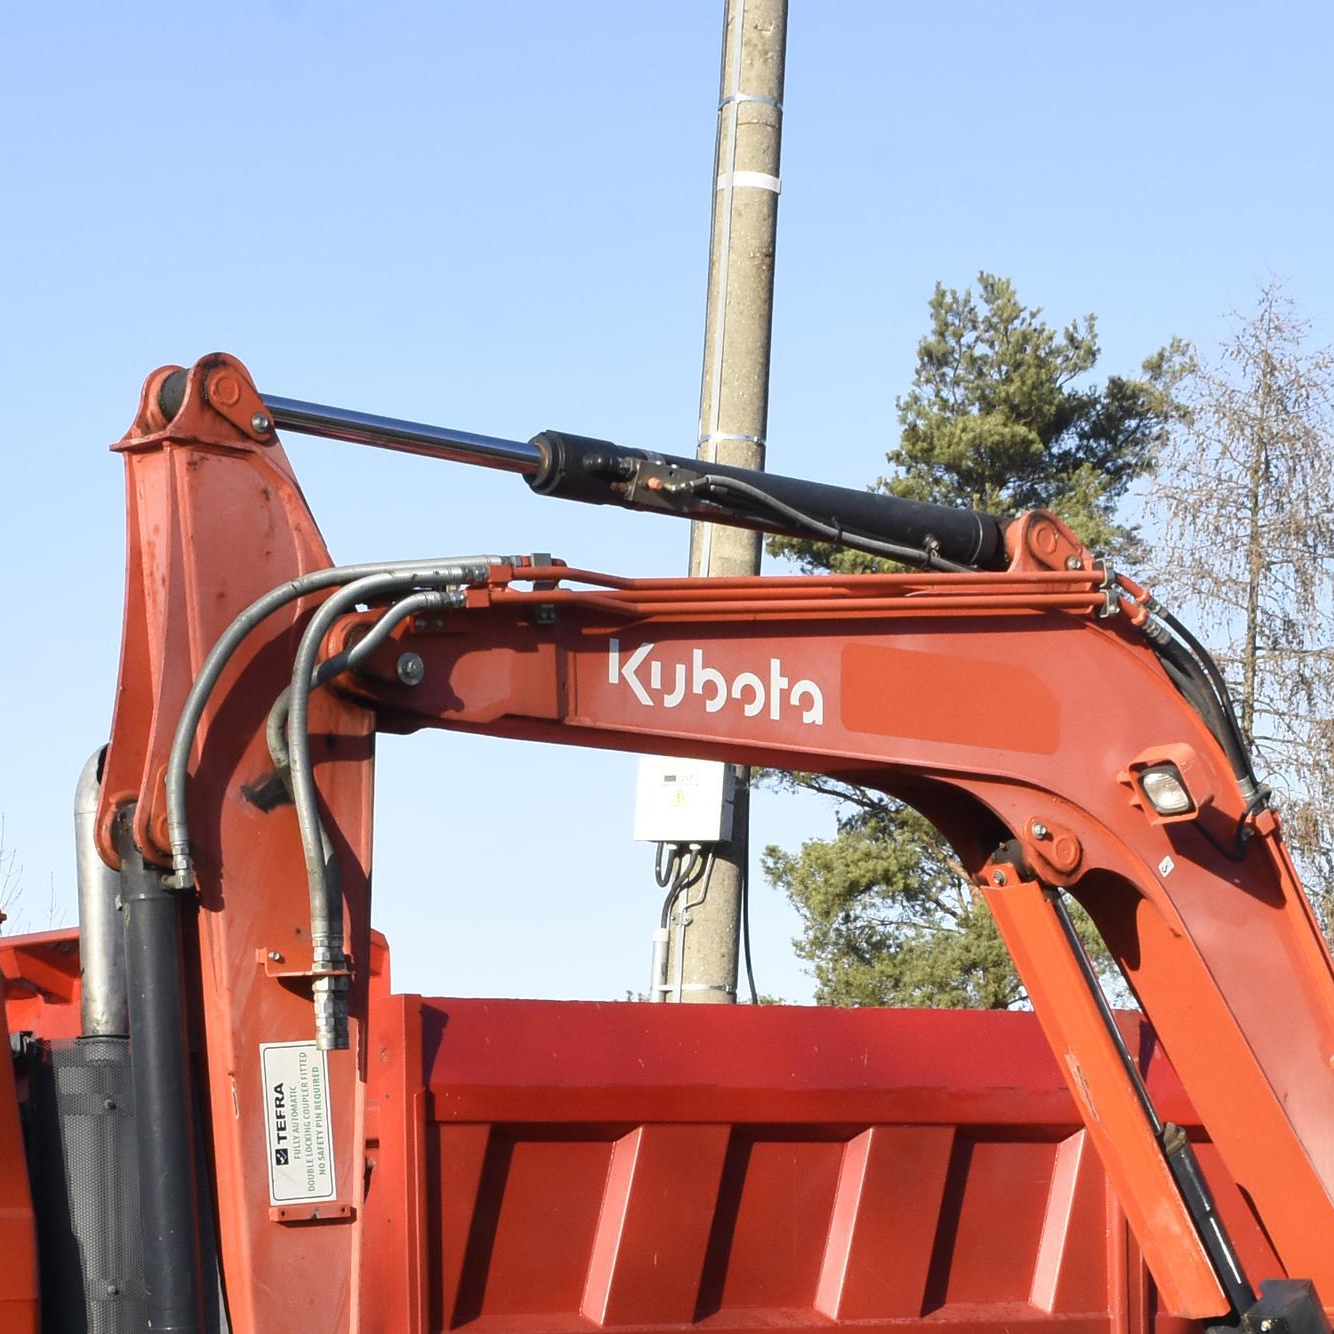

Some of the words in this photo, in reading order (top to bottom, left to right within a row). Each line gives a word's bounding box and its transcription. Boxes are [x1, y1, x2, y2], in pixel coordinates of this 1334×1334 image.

[608, 638, 824, 726] Kubota
[298, 1052, 308, 1081] FITTED
[301, 1082, 311, 1120] COUPLER
[311, 1066, 322, 1111] REQUIRED
[274, 1082, 288, 1145] TEFRA
[289, 1086, 300, 1133] AUTOMATIC
[314, 1112, 323, 1129] PIN
[292, 1135, 302, 1160] FULLY
[303, 1121, 314, 1157] LOCKING
[316, 1130, 326, 1161] SAFETY
[306, 1159, 316, 1192] DOUBLE
[318, 1163, 327, 1176] NO
